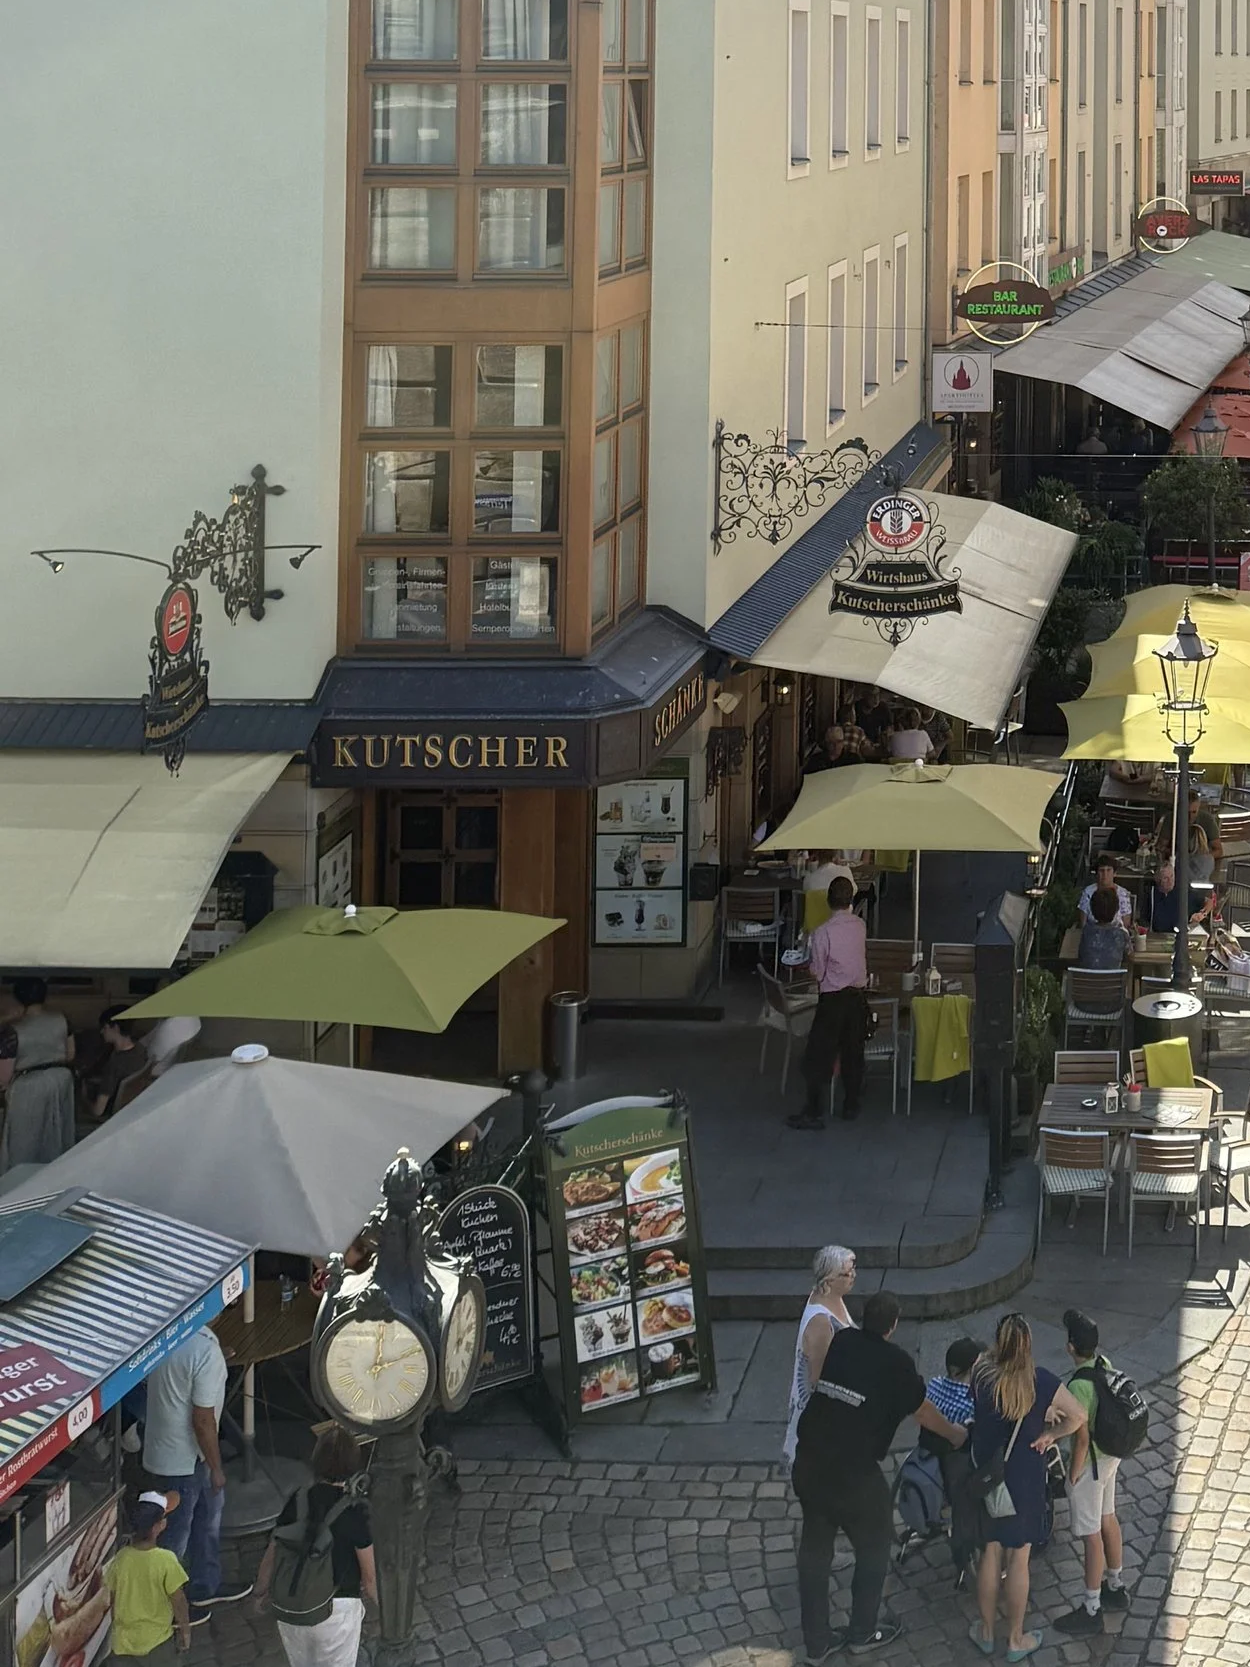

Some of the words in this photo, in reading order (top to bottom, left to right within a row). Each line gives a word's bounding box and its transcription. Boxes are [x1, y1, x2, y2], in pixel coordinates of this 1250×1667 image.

[1192, 175, 1209, 183] LAS
[1211, 175, 1240, 184] TAPAS
[993, 291, 1018, 301] BAR
[967, 303, 1044, 315] RESTAURANT
[872, 500, 920, 520] ERDINGER
[867, 569, 928, 584] Wirtshaus
[837, 591, 956, 612] Kutscherschänke
[654, 671, 704, 748] SCHÄNKE
[332, 734, 569, 769] KUTSCHER
[574, 1128, 664, 1159] Kutscherschänke
[463, 1197, 497, 1216] Stück
[461, 1214, 499, 1228] Kuchen
[128, 1338, 162, 1373] Softdrinks
[165, 1323, 180, 1340] Bier
[183, 1301, 205, 1324] Wasser
[0, 1357, 39, 1379] ger
[7, 1426, 58, 1477] Rostbratwurst
